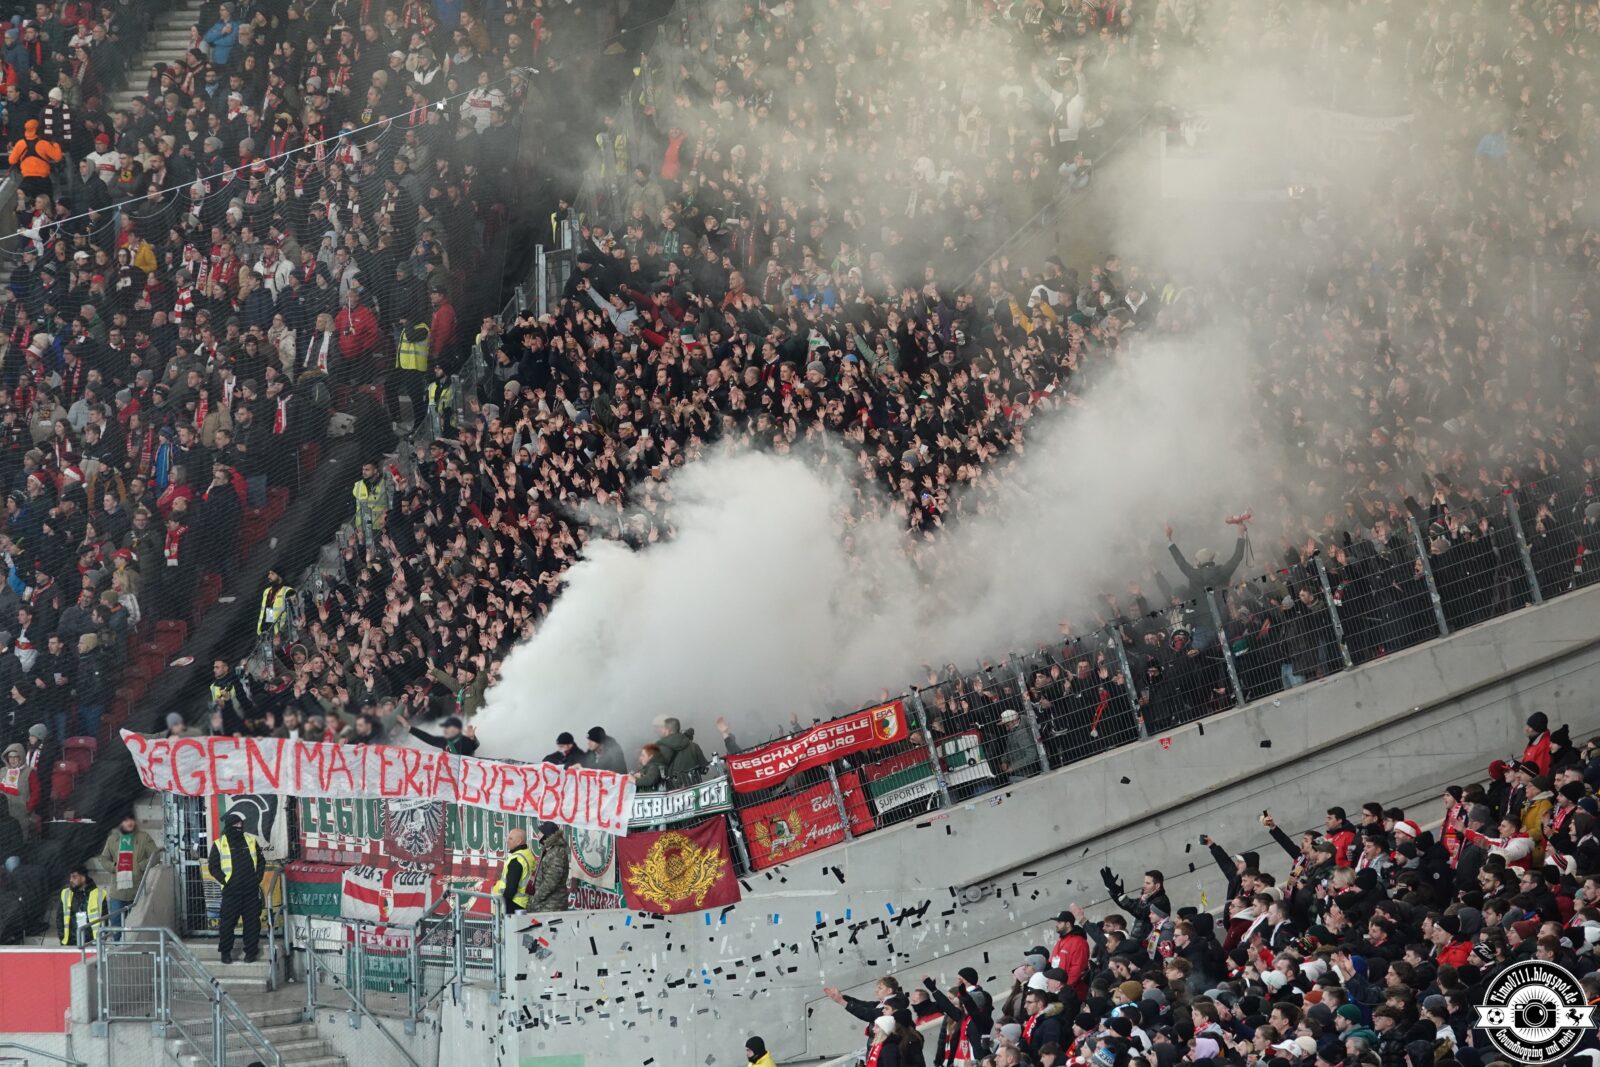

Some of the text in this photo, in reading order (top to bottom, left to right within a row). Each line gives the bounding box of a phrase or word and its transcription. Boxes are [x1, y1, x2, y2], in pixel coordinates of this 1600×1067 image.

[124, 732, 286, 797] GEGEN
[755, 765, 776, 779] FC
[629, 791, 696, 821] GSBURG
[699, 781, 729, 808] OST
[878, 784, 927, 809] SUPPORTER
